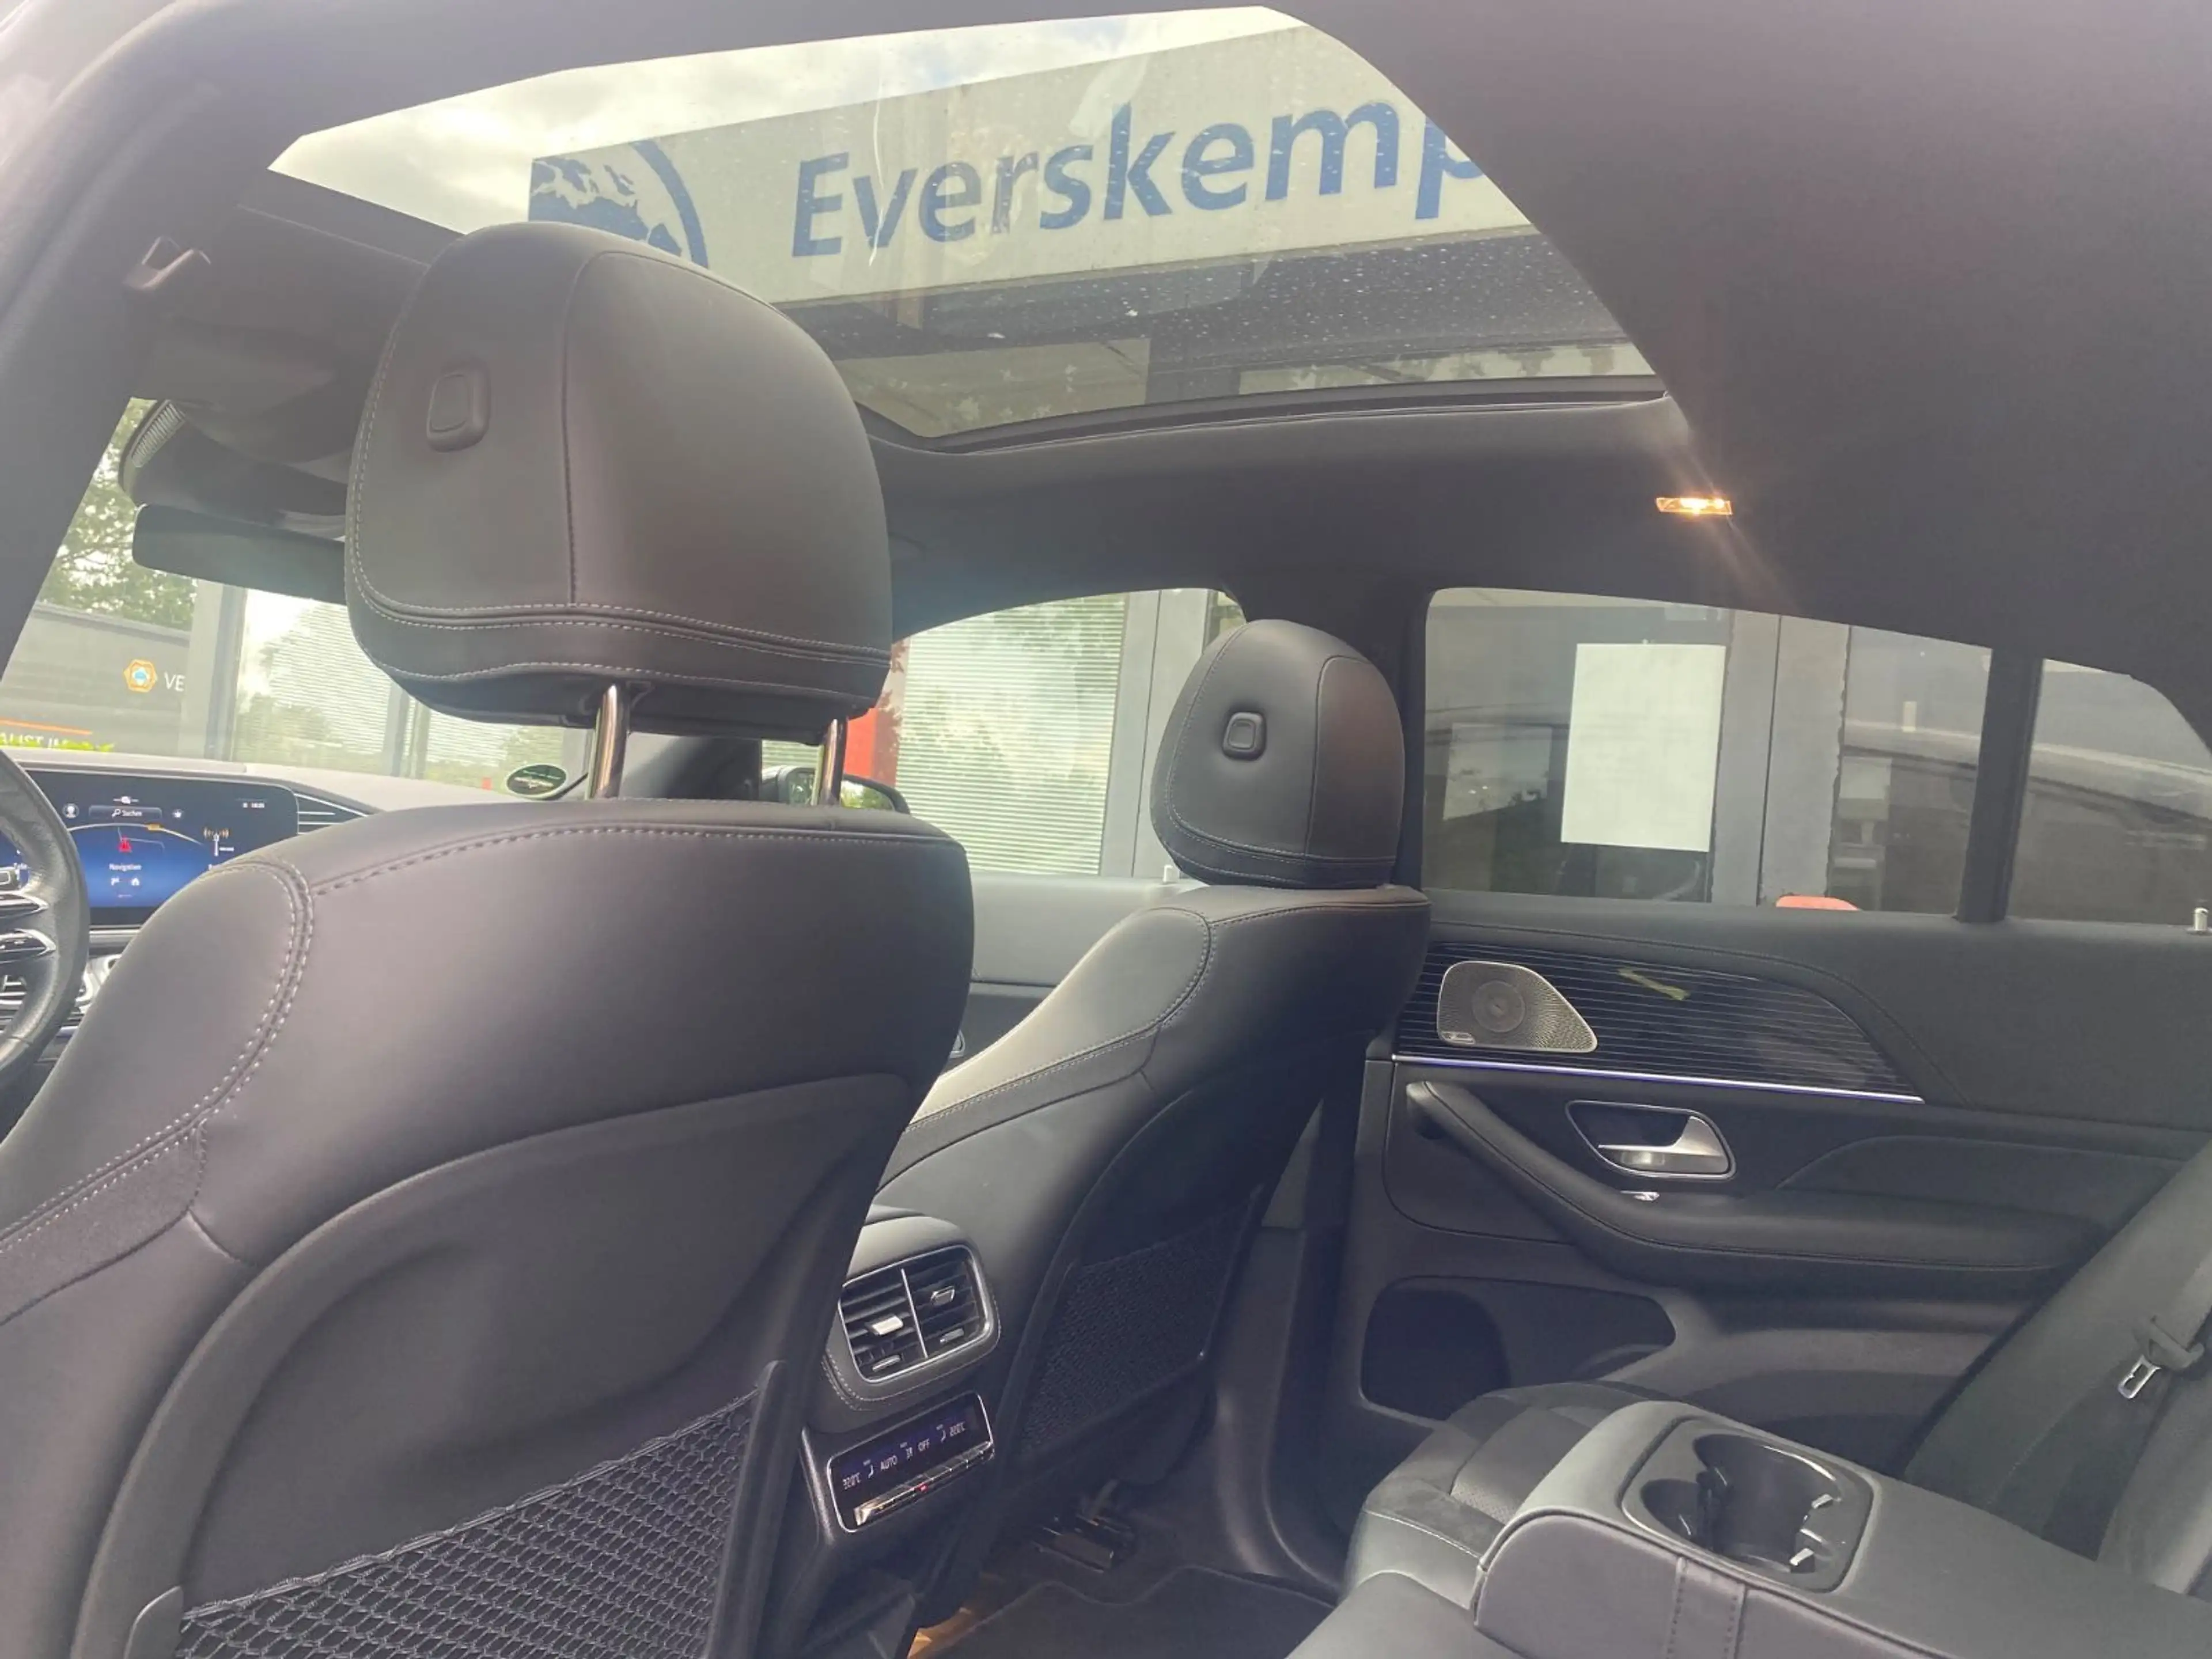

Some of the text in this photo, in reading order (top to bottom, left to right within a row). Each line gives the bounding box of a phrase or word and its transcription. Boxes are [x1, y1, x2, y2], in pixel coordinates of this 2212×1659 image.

[791, 100, 1484, 258] Everskemp
[109, 863, 142, 872] Navigation
[881, 1455, 898, 1471] AUTO
[918, 1438, 930, 1452] OFF
